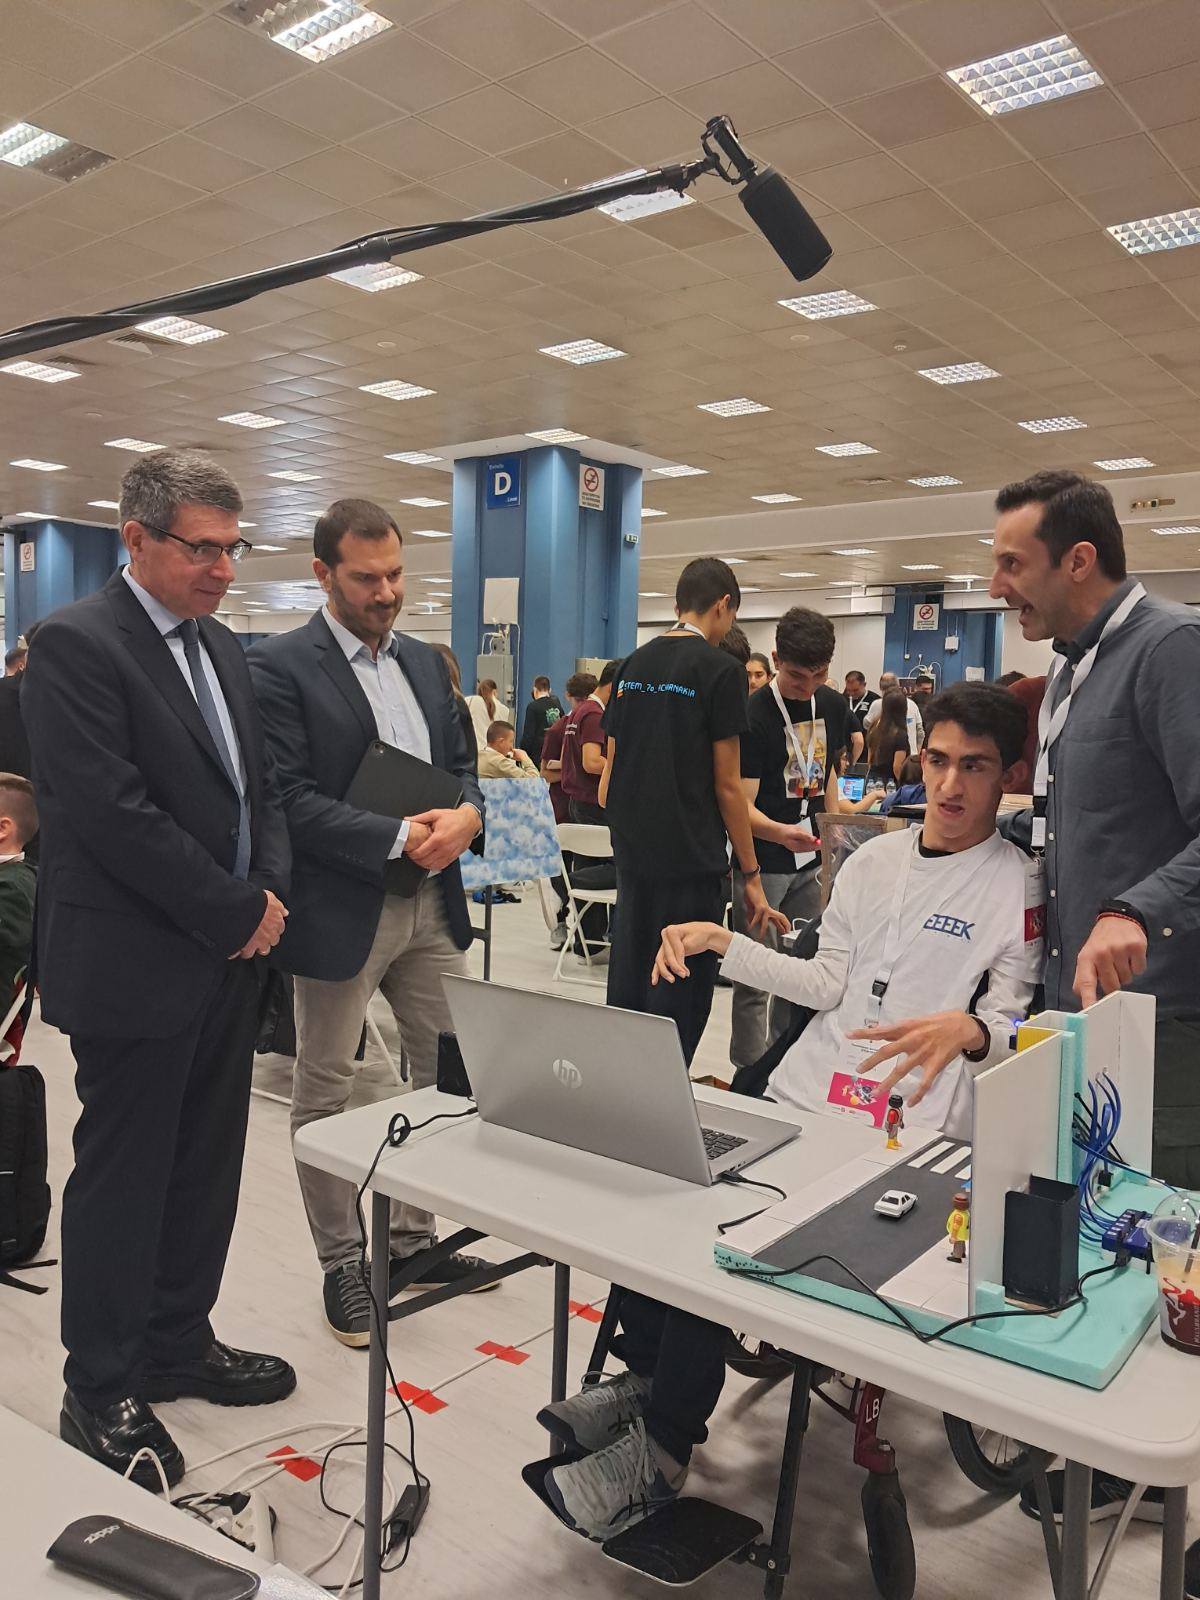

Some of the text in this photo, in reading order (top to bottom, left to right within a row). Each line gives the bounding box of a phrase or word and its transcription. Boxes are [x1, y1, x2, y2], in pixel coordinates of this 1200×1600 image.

[495, 472, 512, 496] D
[552, 1059, 583, 1089] hp
[865, 1398, 880, 1424] LB
